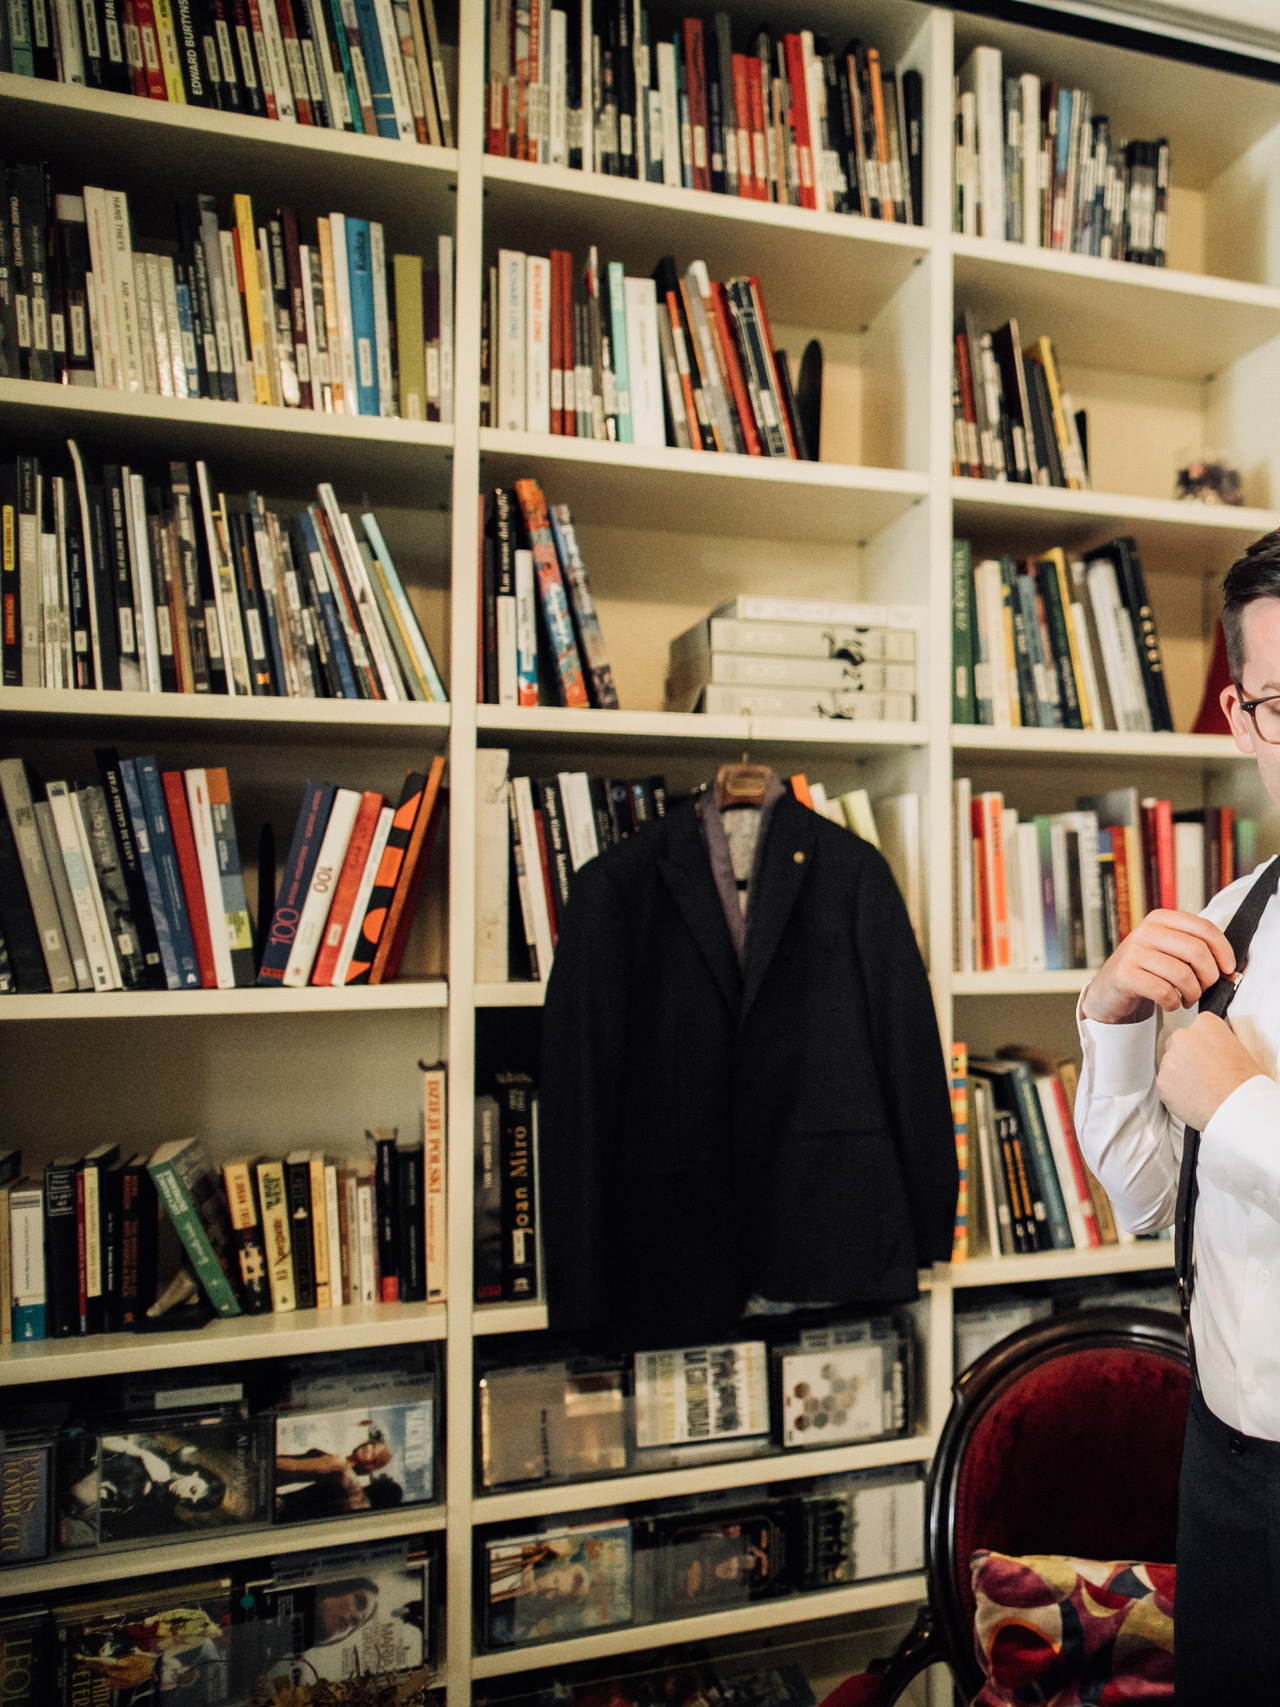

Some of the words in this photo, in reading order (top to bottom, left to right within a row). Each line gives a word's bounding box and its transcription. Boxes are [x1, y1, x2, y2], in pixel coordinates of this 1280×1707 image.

[186, 50, 203, 95] EDWARD
[112, 196, 123, 221] HANS
[12, 227, 23, 267] HORSFIELD
[114, 223, 126, 251] THEYS
[22, 521, 34, 562] RODIN
[312, 865, 333, 893] 100
[270, 907, 299, 946] 100
[507, 1126, 528, 1178] Miró
[21, 1455, 41, 1512] PARIS
